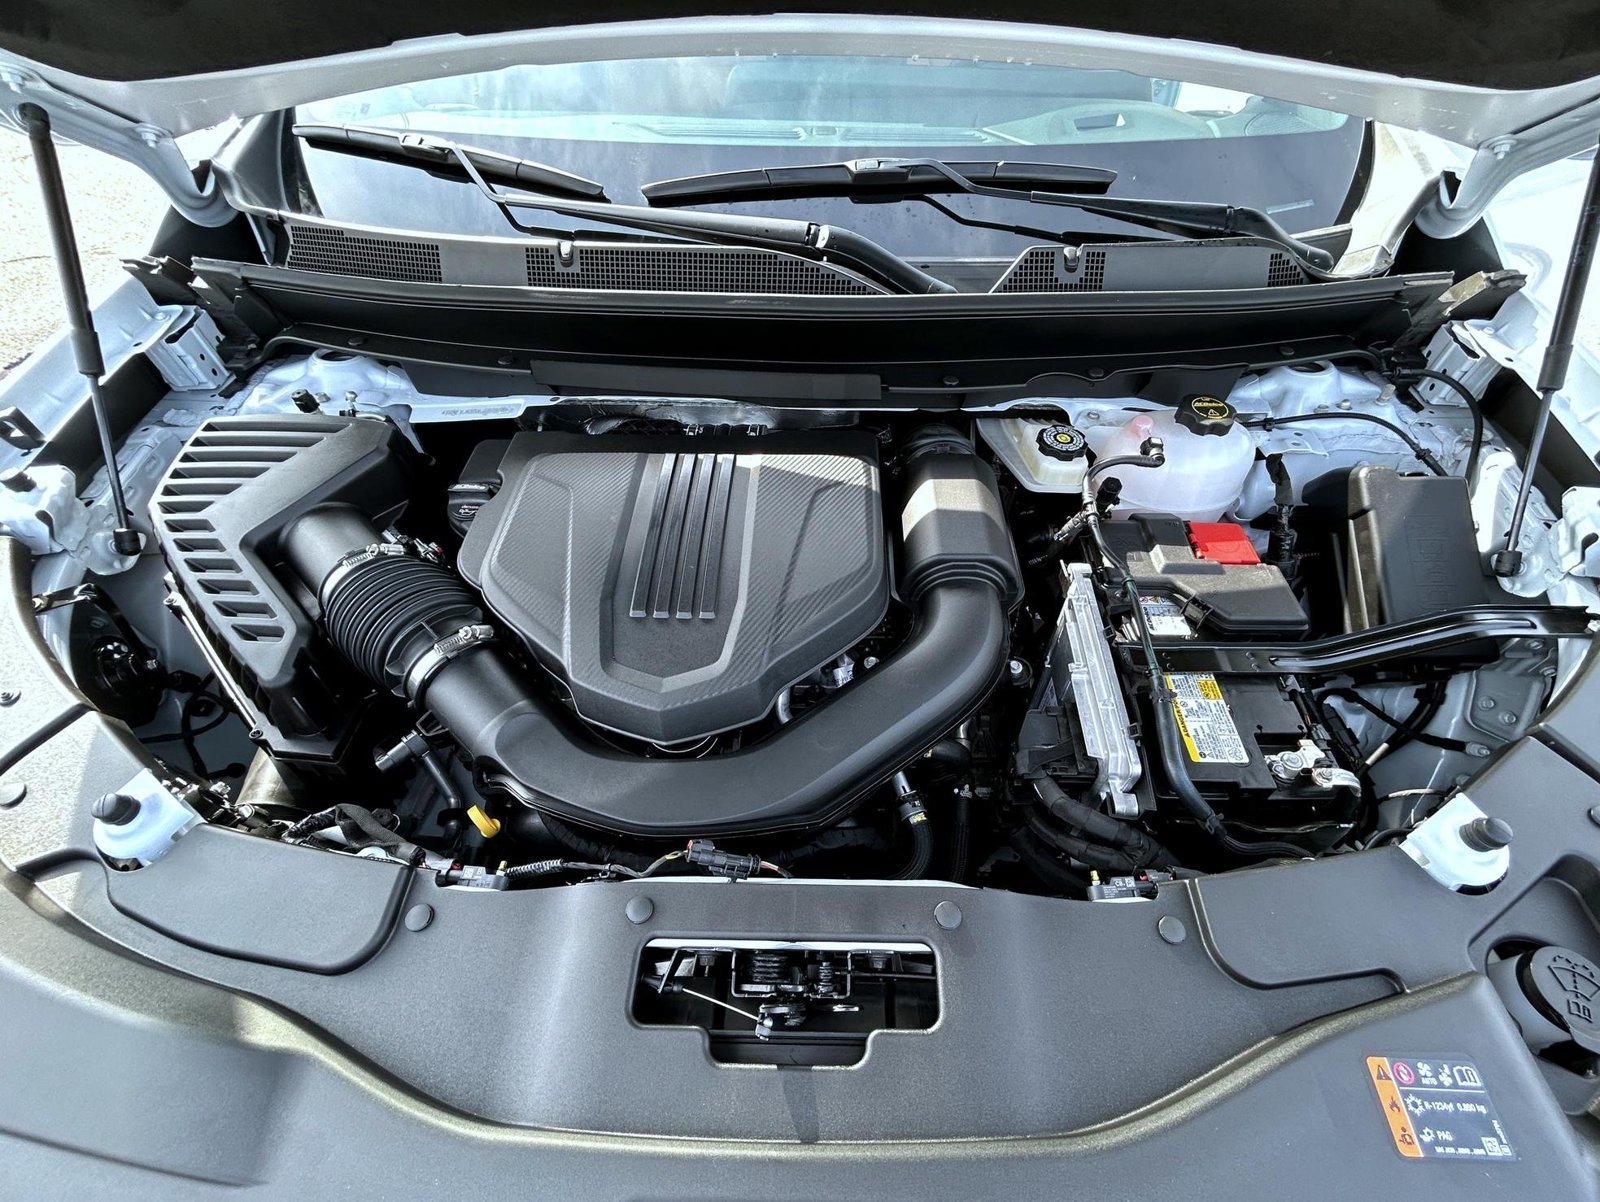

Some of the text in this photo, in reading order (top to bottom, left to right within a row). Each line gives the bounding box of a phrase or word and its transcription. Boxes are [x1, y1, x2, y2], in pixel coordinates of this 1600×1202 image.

[1421, 1077, 1438, 1086] AUTO
[1424, 1101, 1455, 1113] R-1234yf
[1476, 1104, 1487, 1115] kg
[1436, 1130, 1453, 1141] PAG
